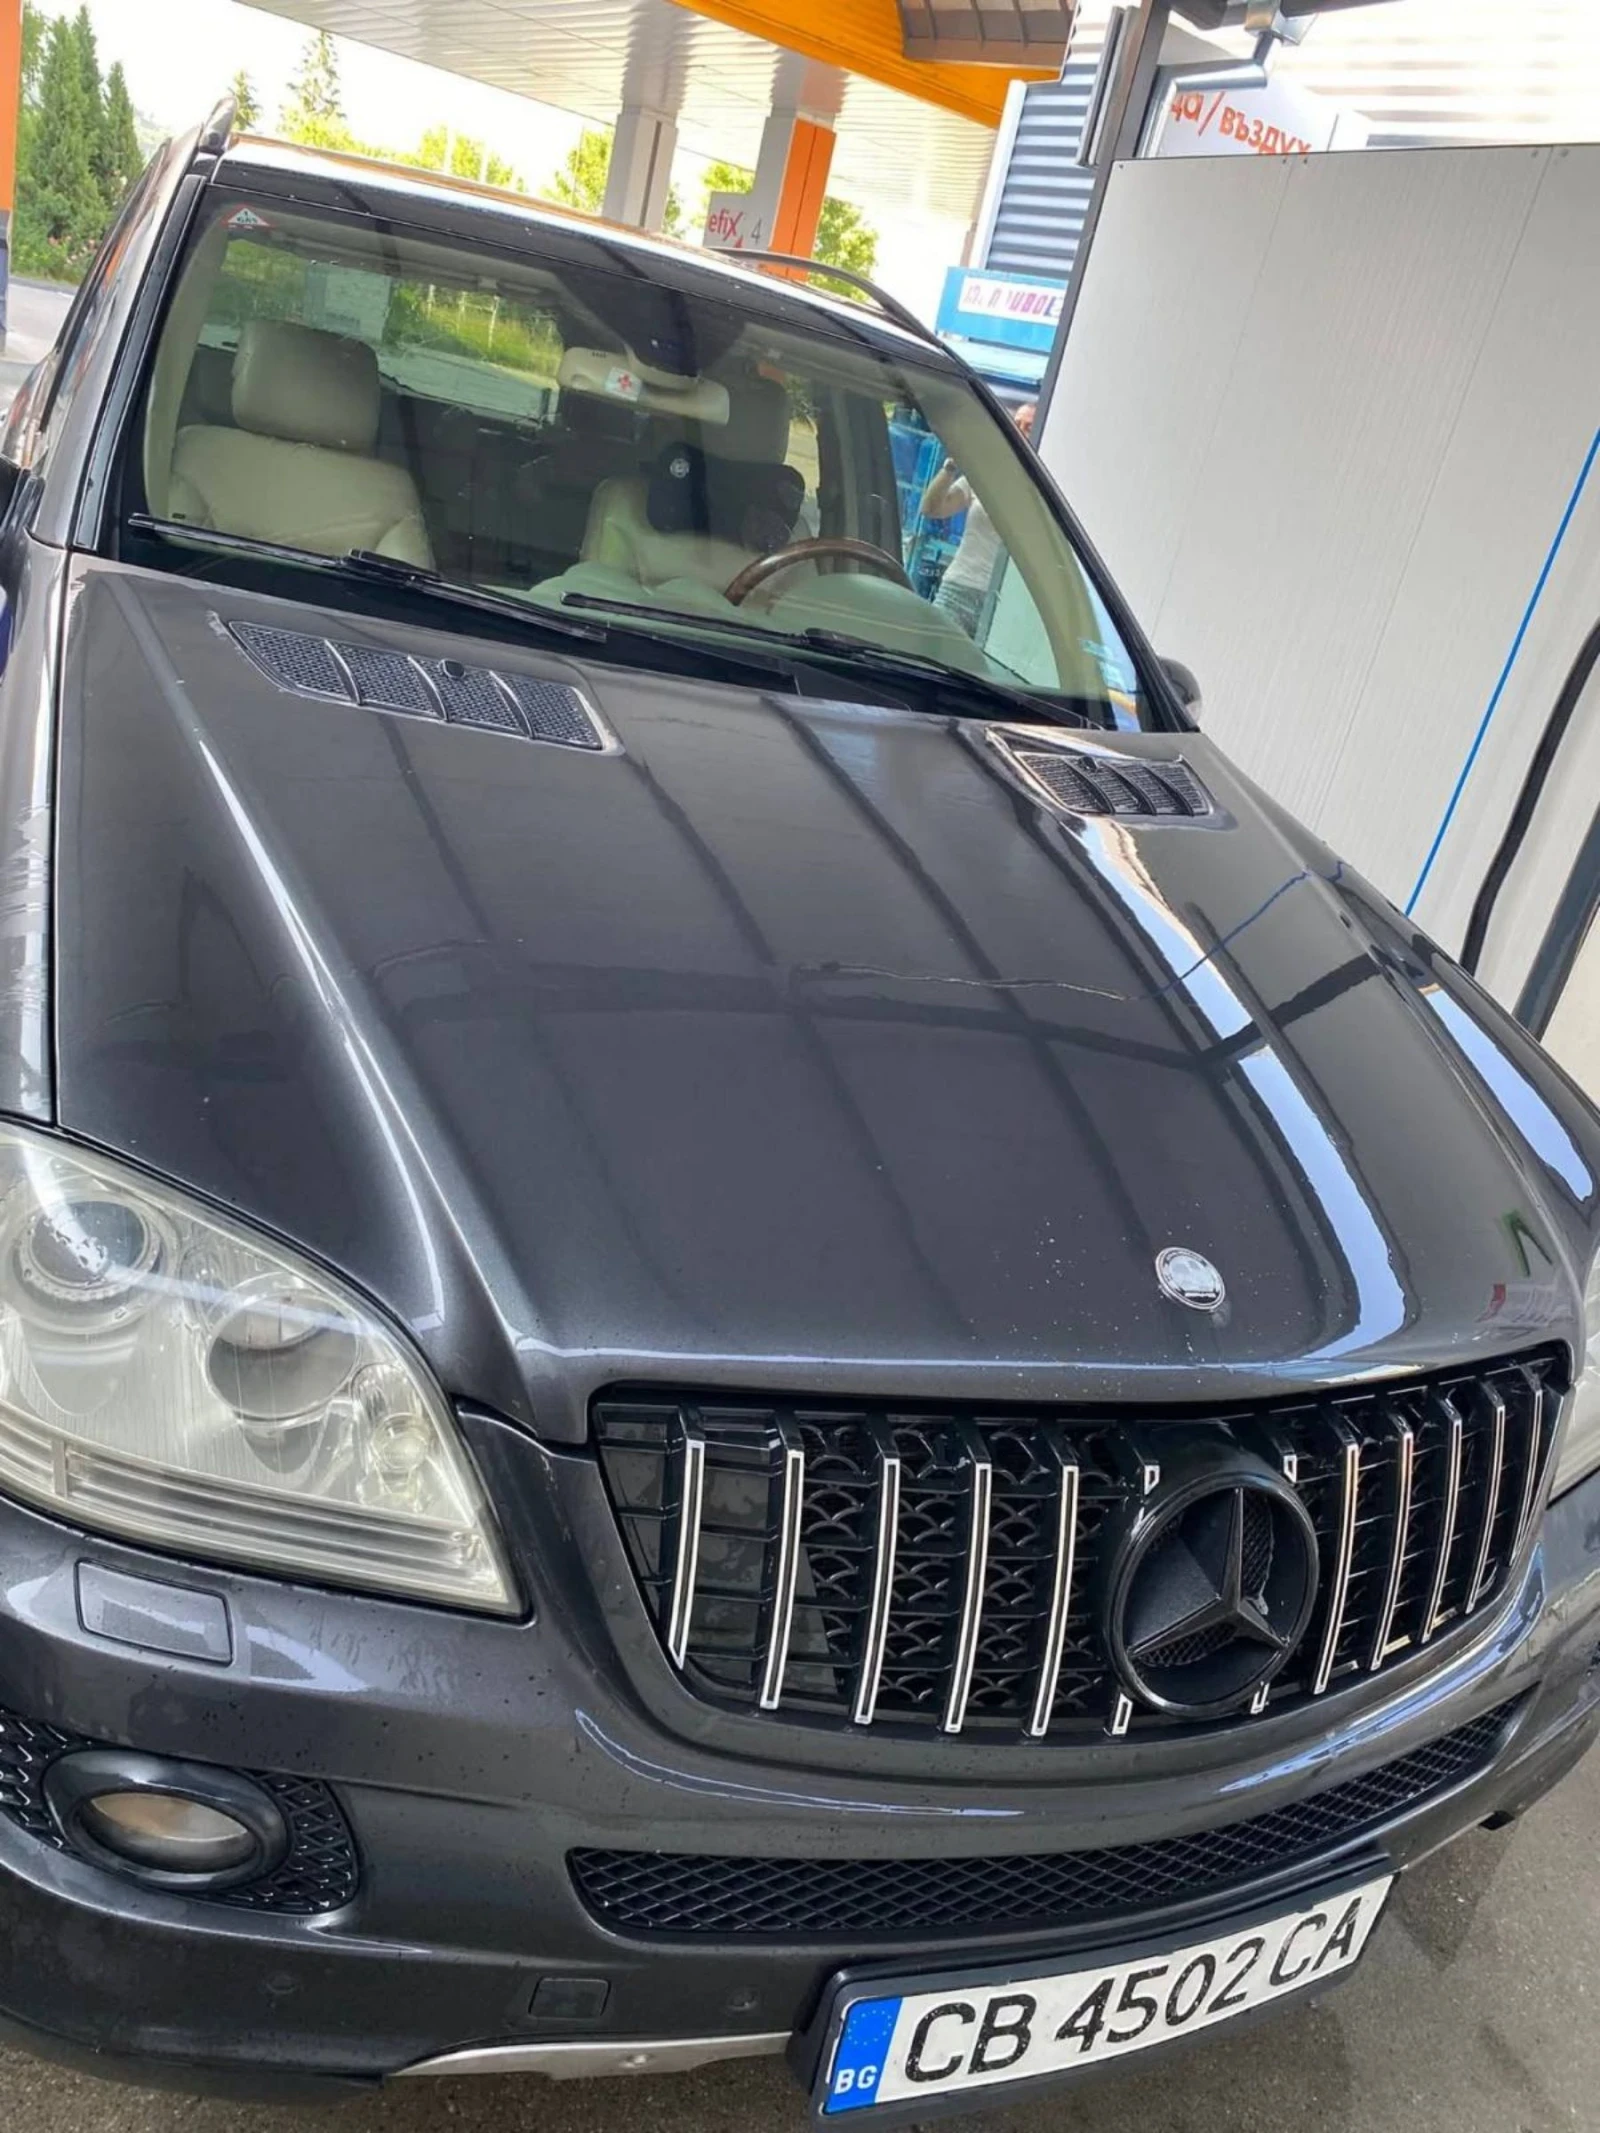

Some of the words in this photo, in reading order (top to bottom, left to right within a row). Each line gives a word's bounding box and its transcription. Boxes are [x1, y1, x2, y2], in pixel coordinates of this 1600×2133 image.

[707, 208, 744, 242] efix
[751, 217, 762, 244] 4
[904, 1993, 1037, 2083] CB
[1055, 1935, 1266, 2054] 4502
[1269, 1896, 1363, 1986] CA
[834, 2065, 878, 2095] BG
